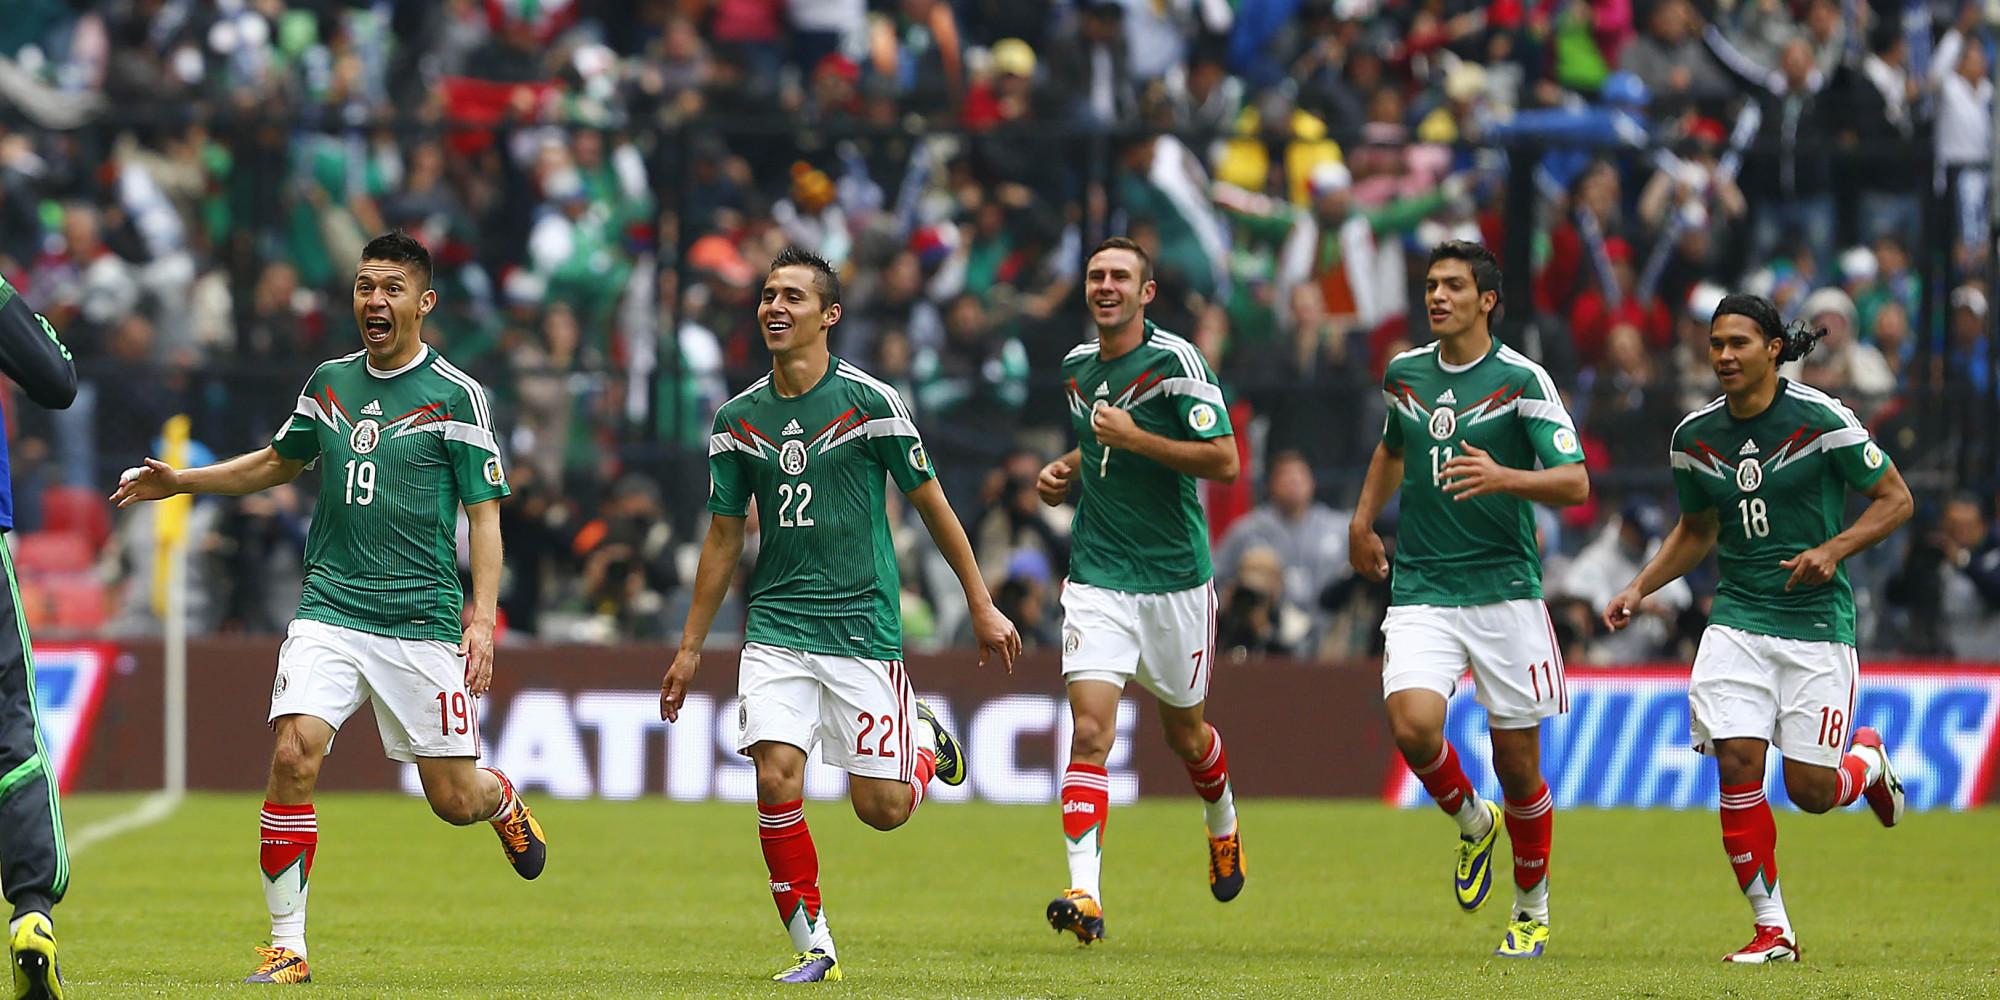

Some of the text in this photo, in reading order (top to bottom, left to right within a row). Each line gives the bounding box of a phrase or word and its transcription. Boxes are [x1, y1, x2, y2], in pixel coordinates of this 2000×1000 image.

[344, 459, 376, 506] 19
[1429, 446, 1454, 487] 11
[778, 483, 815, 528] 22
[1737, 498, 1770, 540] 18
[1189, 649, 1204, 690] 7
[1528, 660, 1554, 703] 11
[435, 691, 469, 736] 19
[856, 711, 896, 758] 22
[1817, 706, 1844, 749] 18
[400, 688, 1140, 804] ATICE
[1414, 684, 1990, 811] SNICRS
